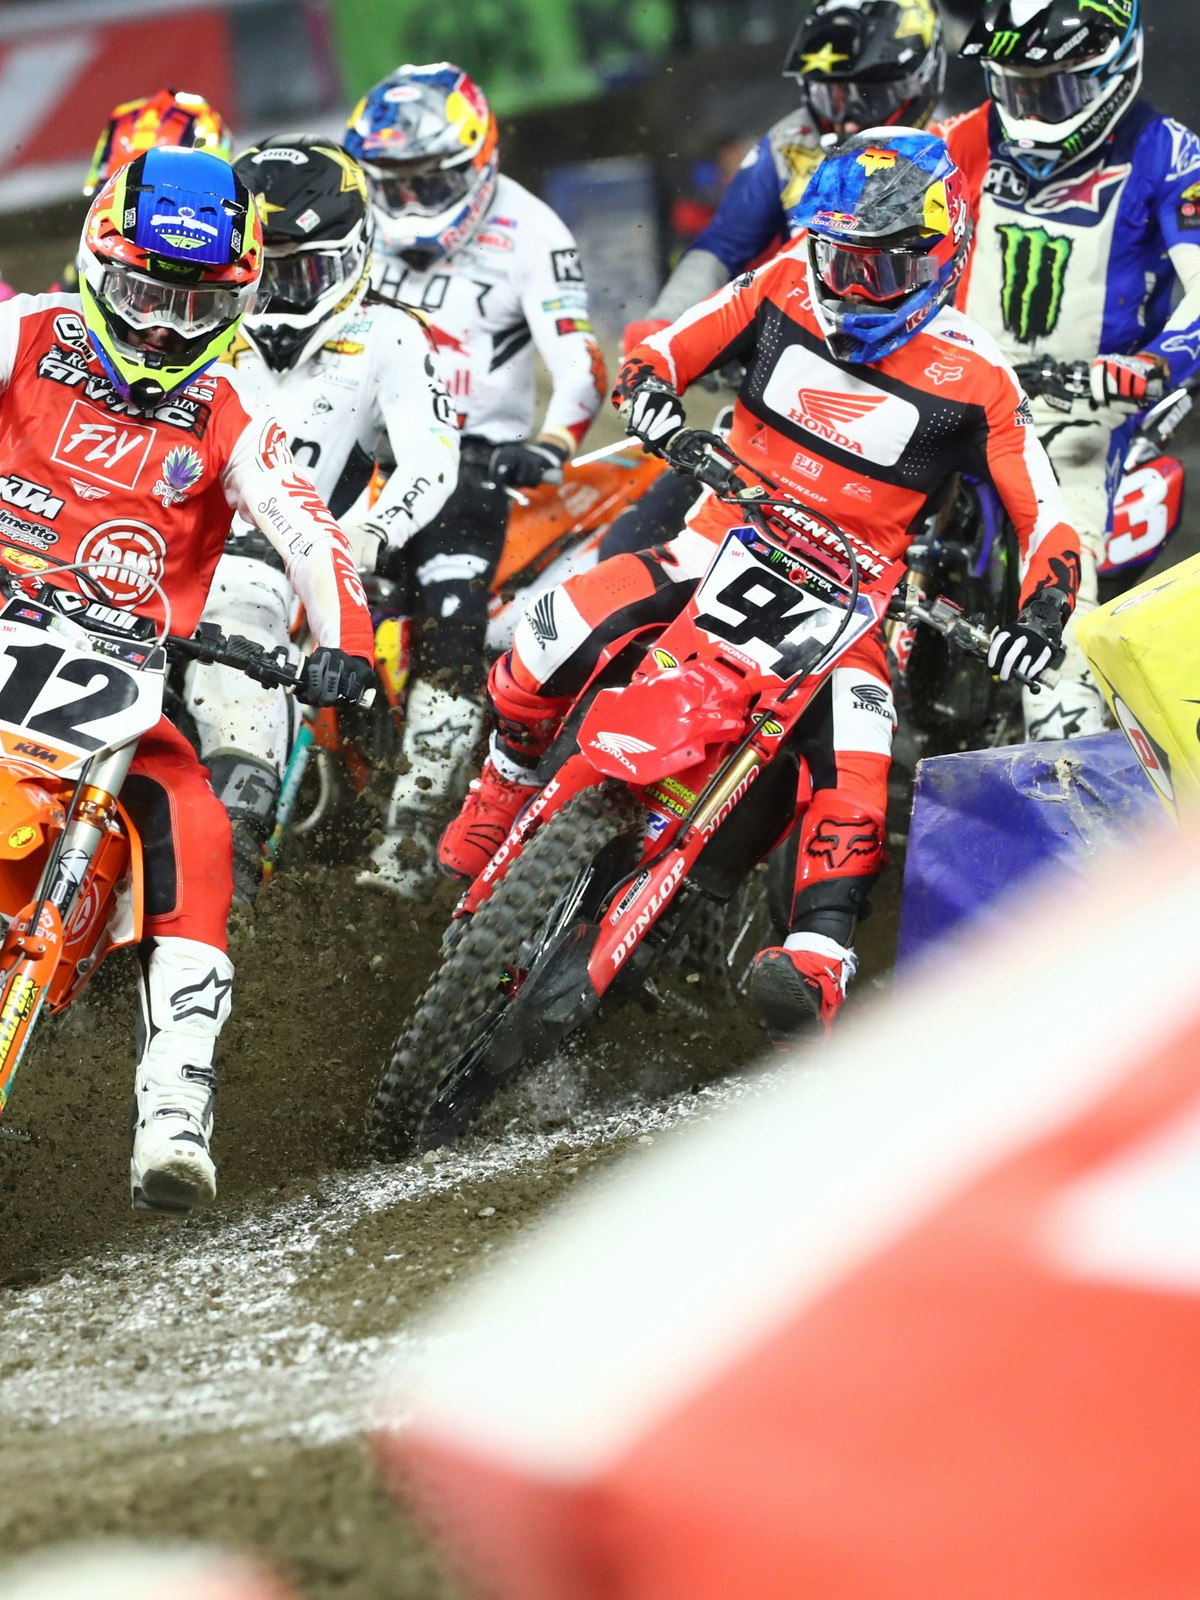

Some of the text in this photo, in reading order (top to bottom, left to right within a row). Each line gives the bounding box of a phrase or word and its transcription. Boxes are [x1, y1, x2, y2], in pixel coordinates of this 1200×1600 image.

[786, 286, 816, 312] FO
[63, 423, 144, 469] FLY
[786, 407, 864, 456] HONDA
[779, 476, 828, 503] DUNLOP
[1109, 467, 1169, 566] 3
[719, 641, 758, 671] HONDA
[13, 741, 59, 764] KTM
[588, 739, 638, 775] HONDA
[482, 777, 561, 883] DUNLOP
[610, 856, 685, 970] DUNLOP
[16, 921, 59, 945] DBYA
